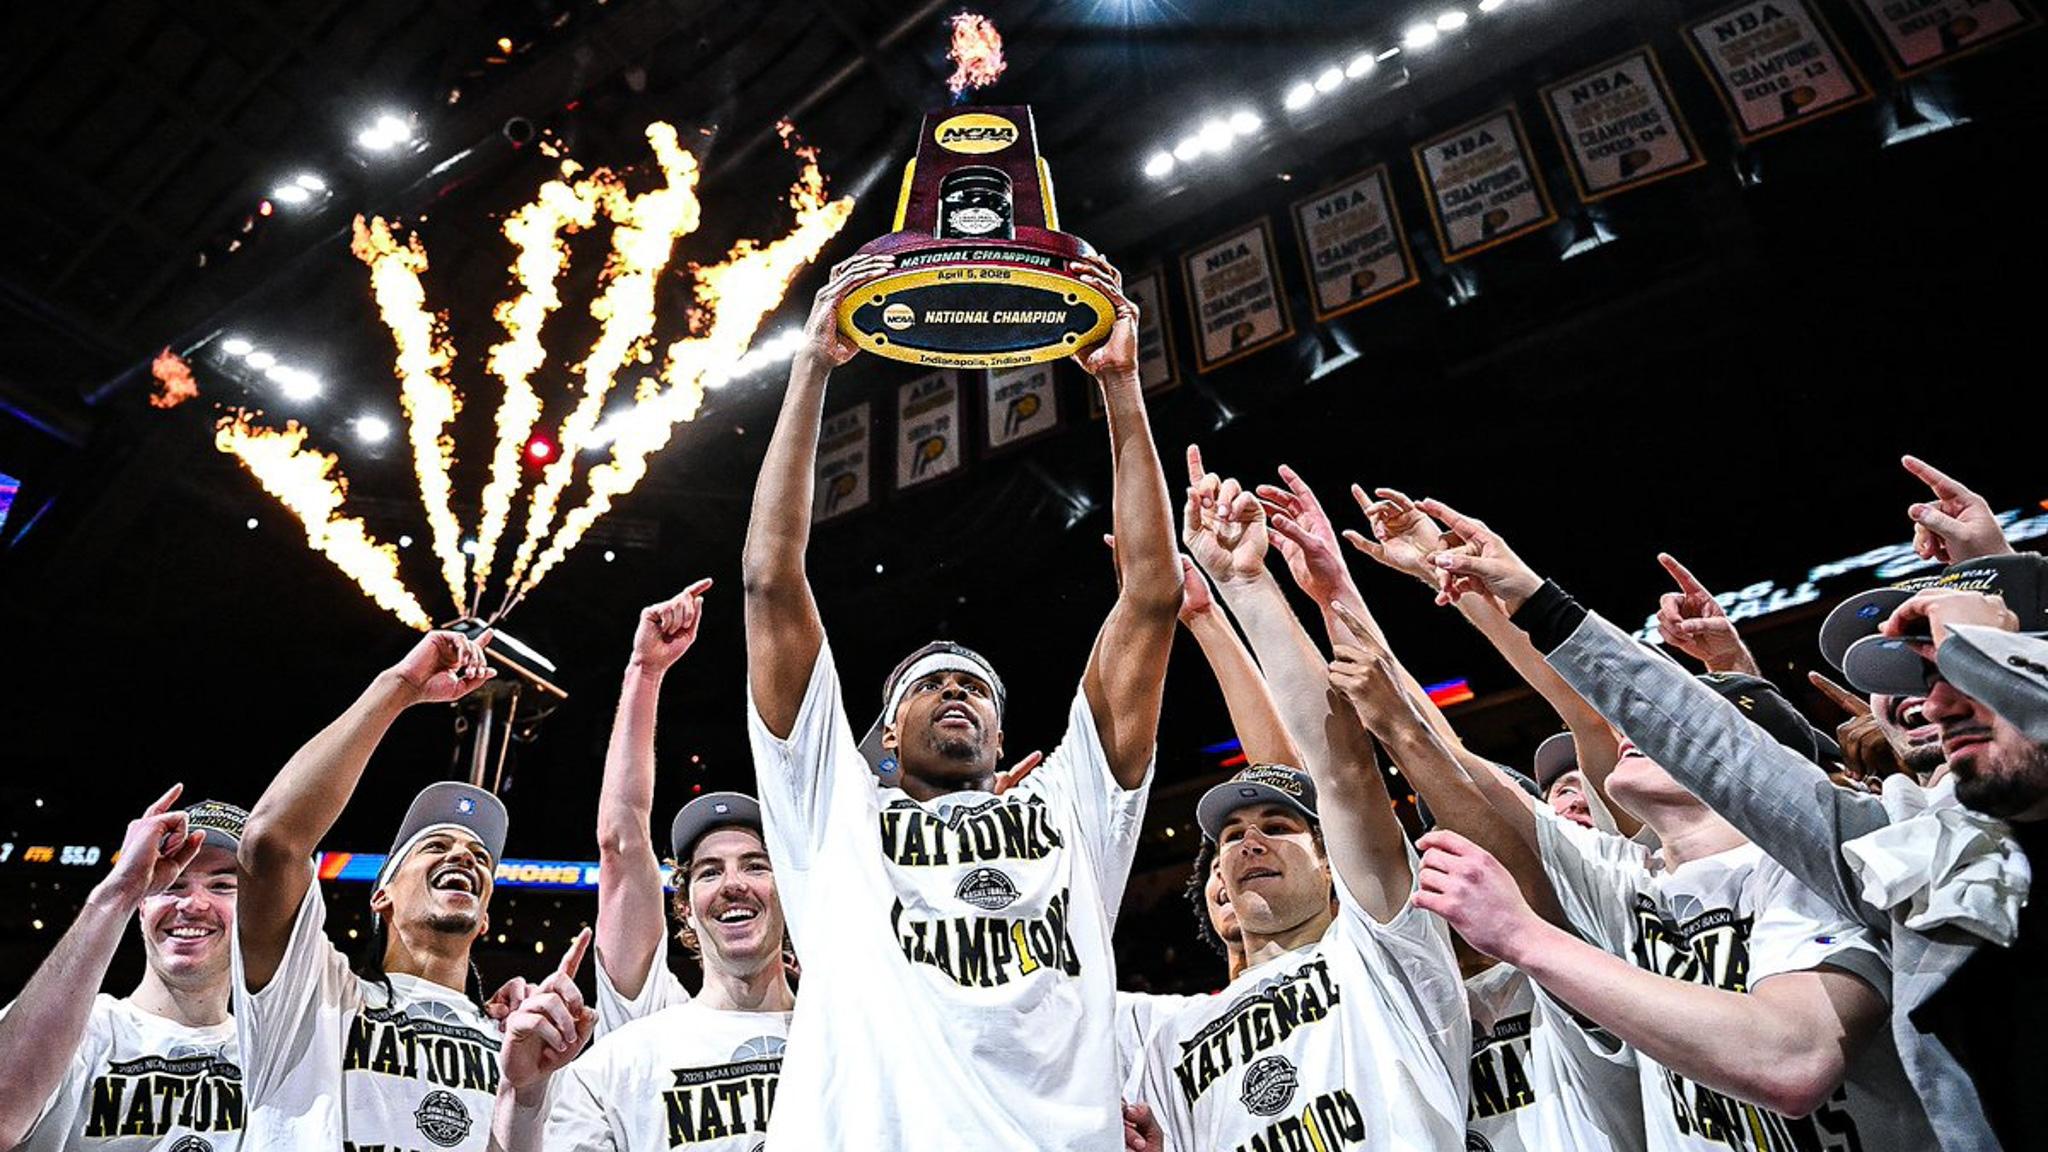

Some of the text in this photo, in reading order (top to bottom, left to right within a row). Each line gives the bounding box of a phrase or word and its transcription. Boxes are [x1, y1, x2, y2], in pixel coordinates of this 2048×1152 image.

[1714, 4, 1783, 42] NBA
[1570, 72, 1633, 104] NBA
[942, 127, 1014, 143] NCAA
[1441, 131, 1495, 160] NBA
[900, 250, 1051, 268] NATIONAL CHAMPION
[938, 268, 963, 280] April
[887, 311, 1067, 324] NCAA NATIONAL CHAMPION
[991, 355, 1032, 366] Indiana
[879, 803, 1064, 866] NATIONAL
[1174, 960, 1341, 1112] NATIONAL
